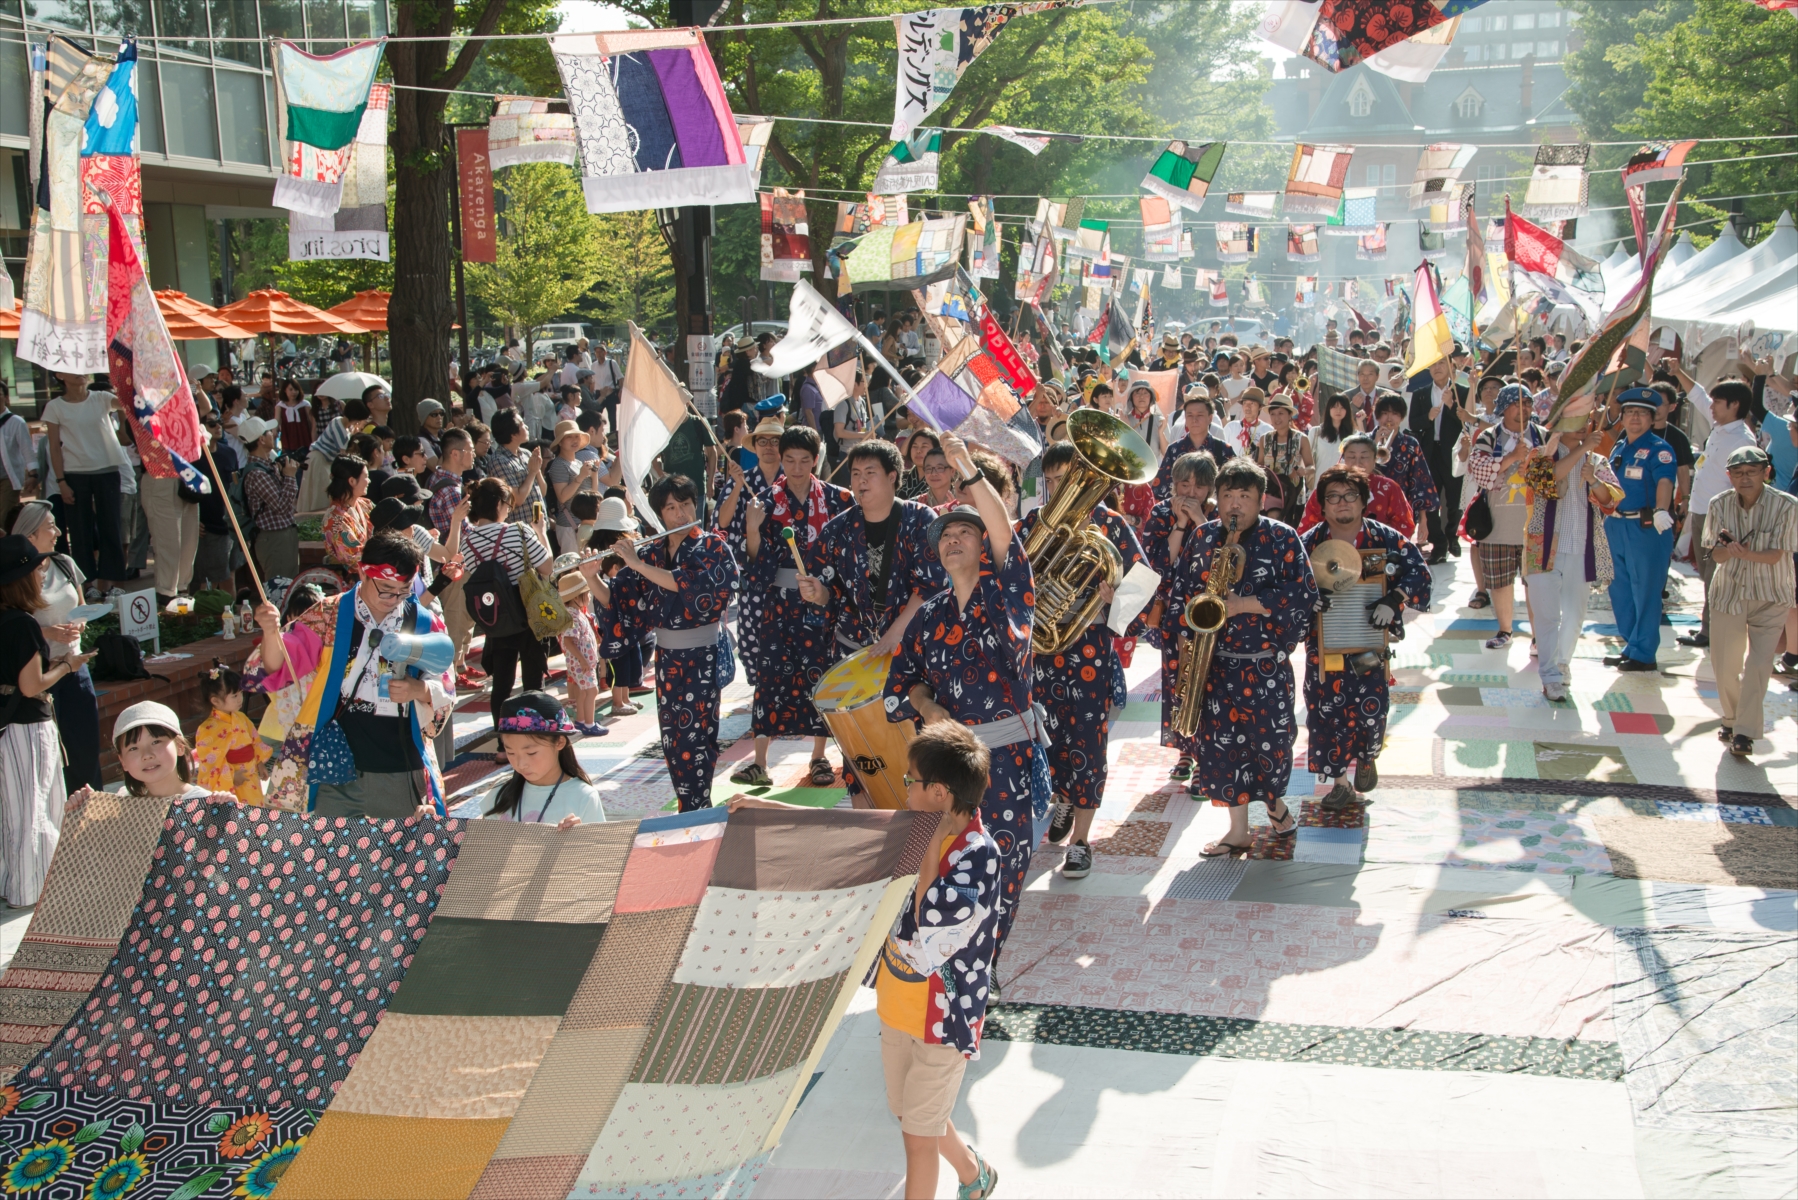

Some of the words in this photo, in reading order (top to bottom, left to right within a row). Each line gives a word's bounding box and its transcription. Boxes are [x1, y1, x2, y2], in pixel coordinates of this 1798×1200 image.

[467, 170, 475, 222] TERRACE
[474, 152, 487, 240] Akarenga
[128, 623, 156, 635] スケートボード禁止
